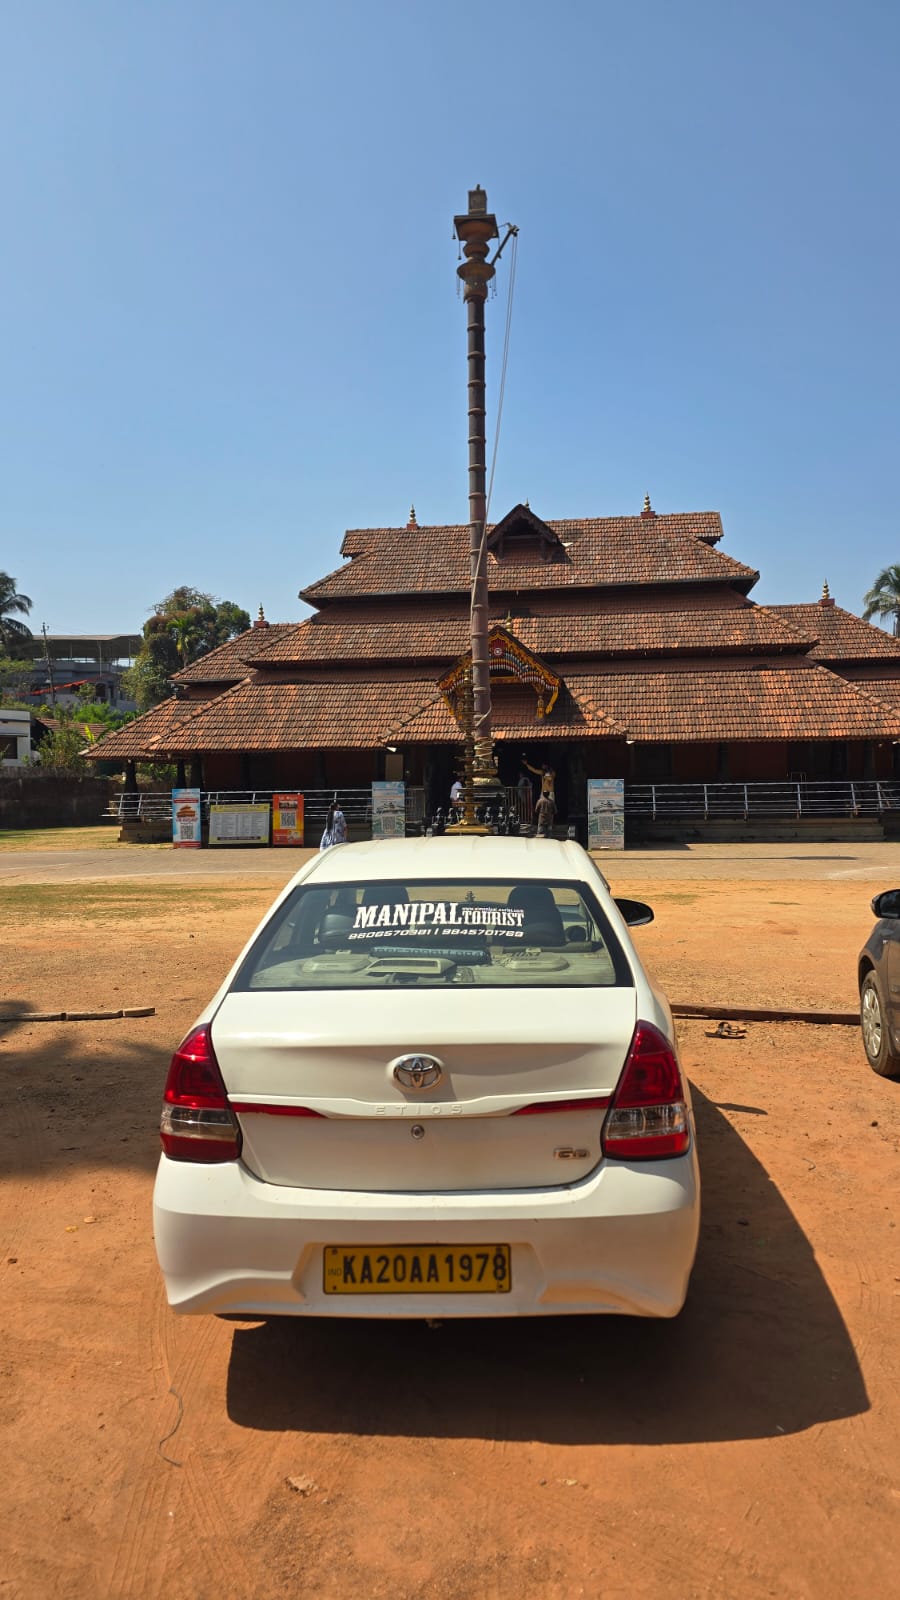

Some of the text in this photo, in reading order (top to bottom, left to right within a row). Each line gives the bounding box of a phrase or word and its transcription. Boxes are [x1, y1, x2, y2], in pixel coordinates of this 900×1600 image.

[353, 903, 524, 928] MANIPAL TOURIST
[375, 1104, 463, 1116] ETIOS
[343, 1254, 507, 1284] KA20AA1978
